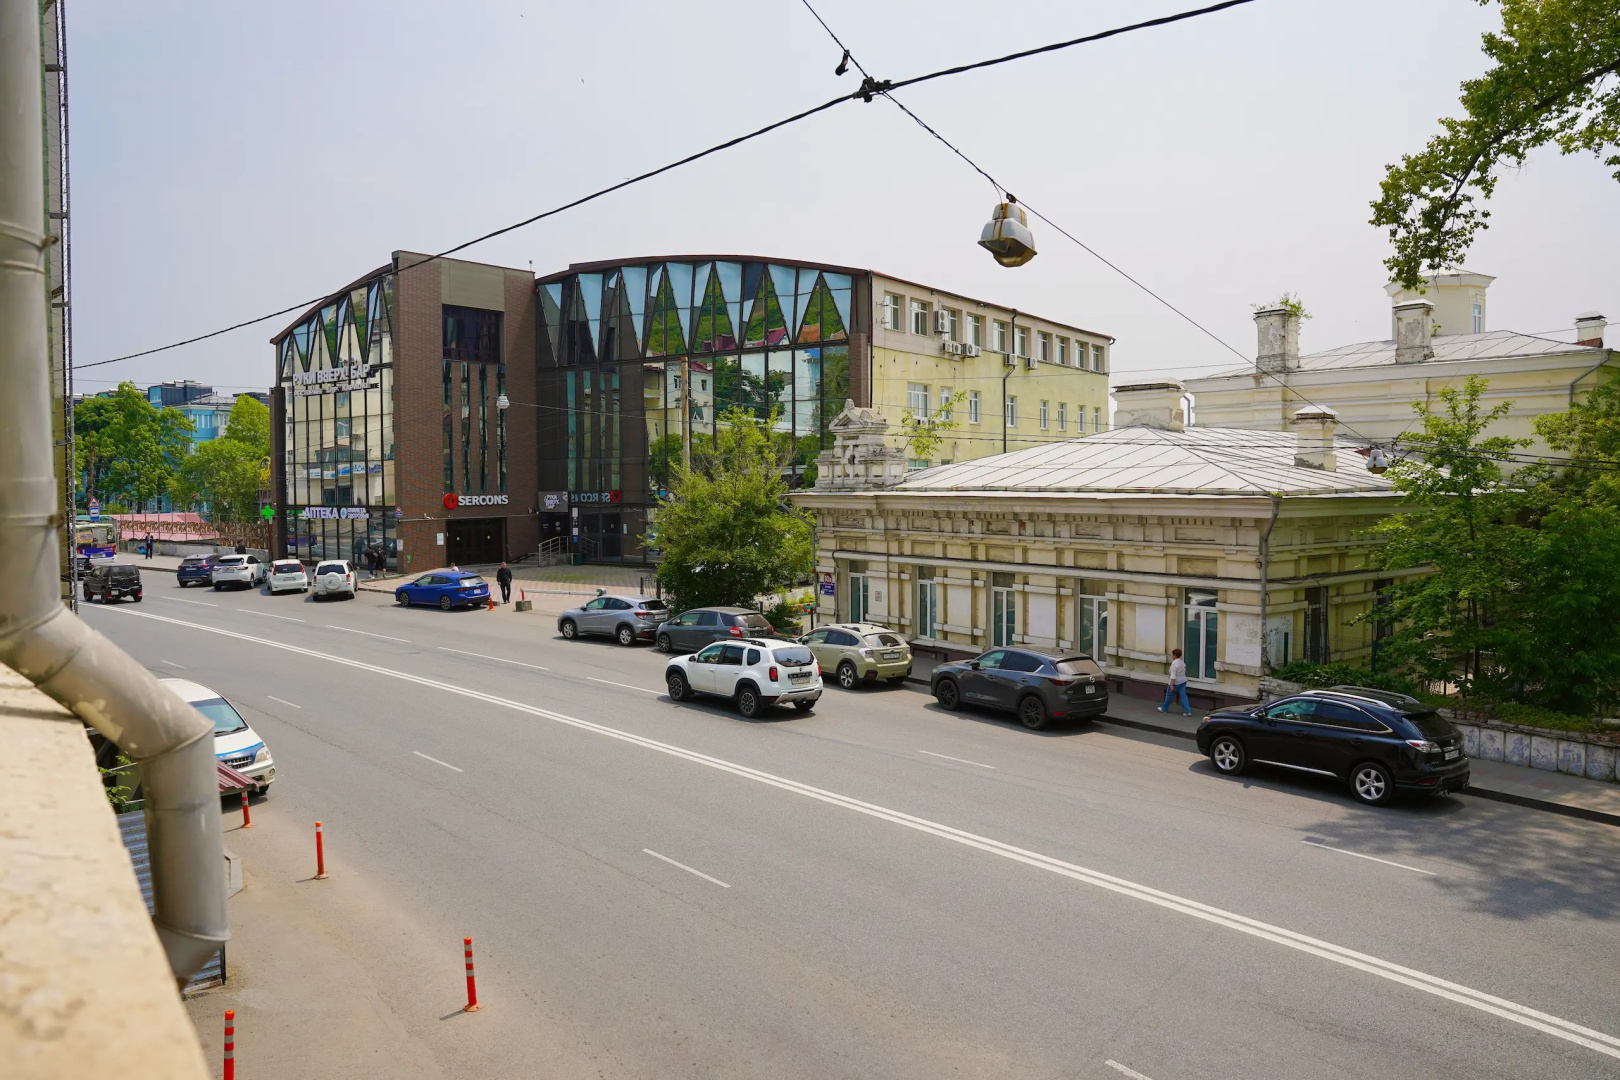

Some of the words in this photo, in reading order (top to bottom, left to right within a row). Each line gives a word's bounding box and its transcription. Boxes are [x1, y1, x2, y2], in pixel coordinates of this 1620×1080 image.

[293, 371, 316, 386] РУКИ
[350, 364, 370, 379] БАР
[457, 494, 508, 506] SERCONS
[303, 507, 340, 519] АПТЕКА
